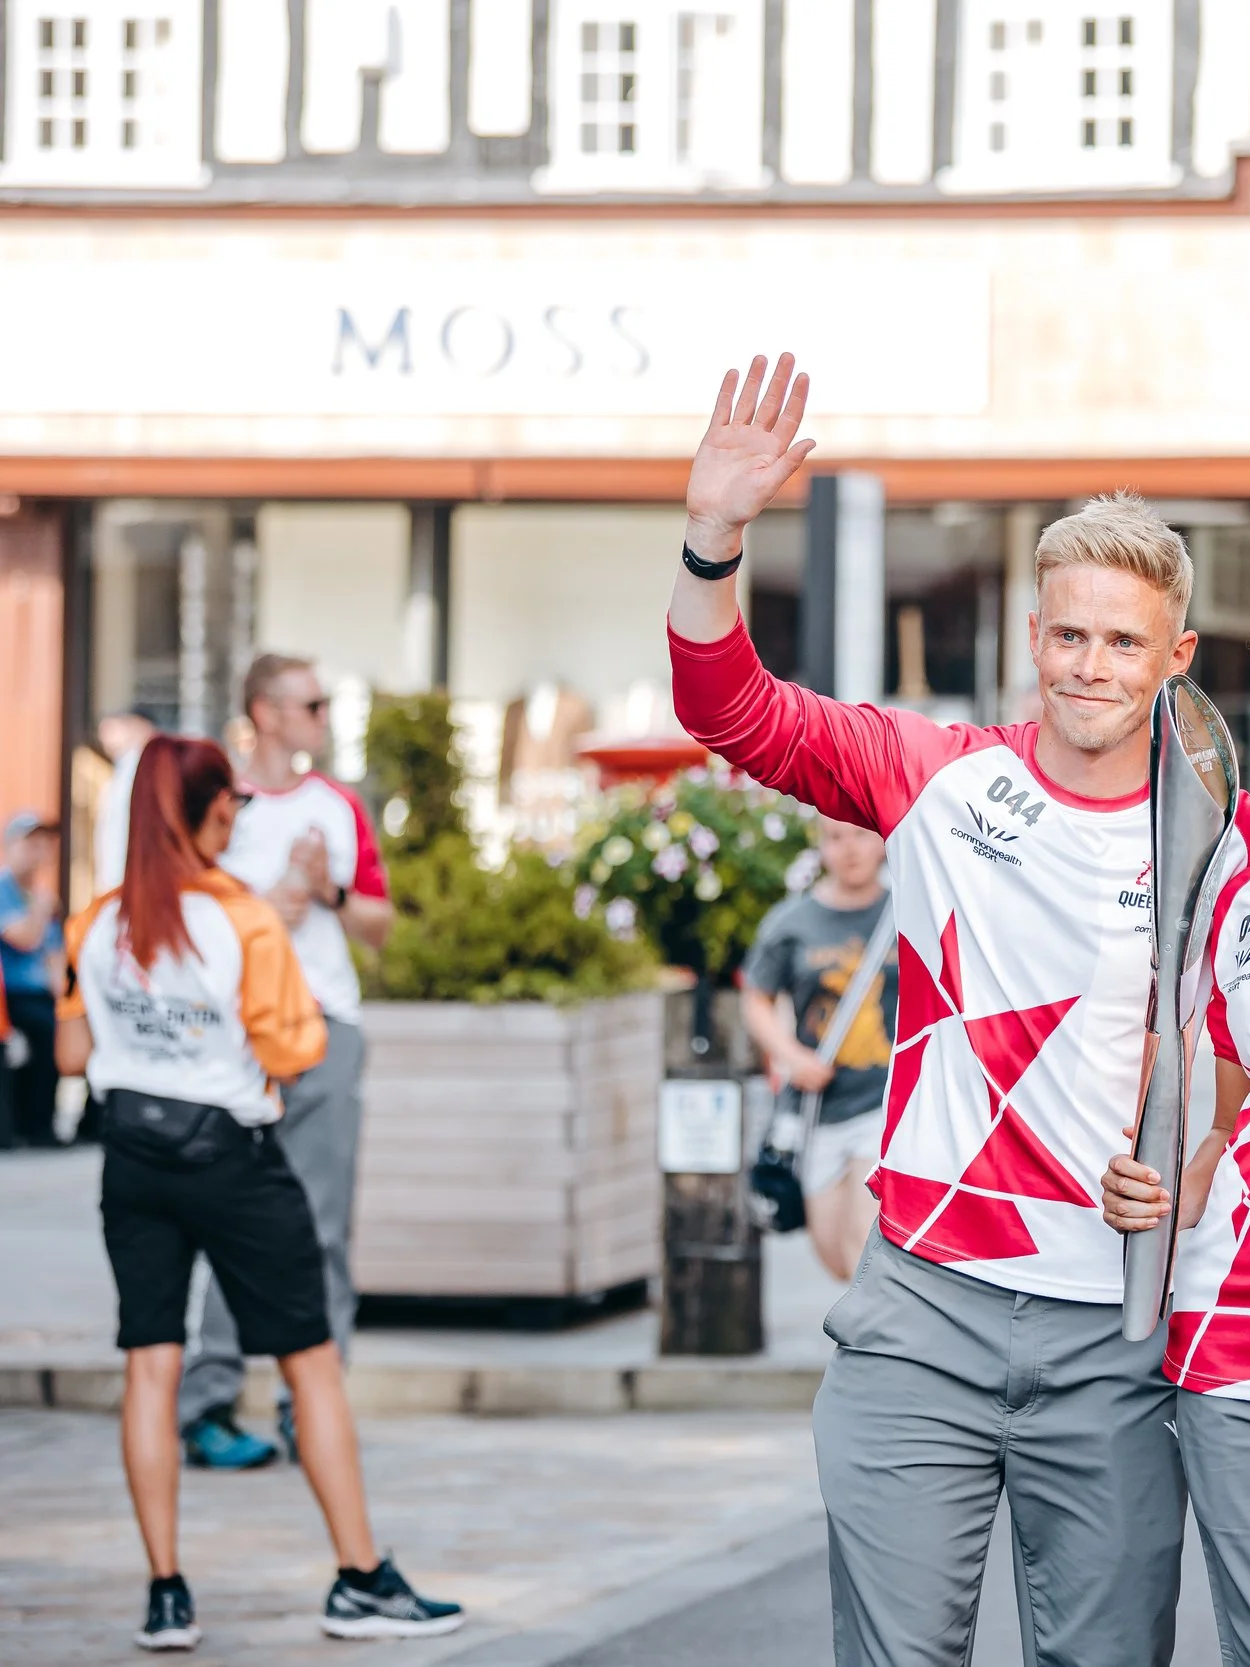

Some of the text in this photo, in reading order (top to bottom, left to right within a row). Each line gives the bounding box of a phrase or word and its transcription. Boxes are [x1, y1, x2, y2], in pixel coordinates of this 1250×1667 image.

[331, 304, 650, 379] MOSS
[986, 776, 1046, 827] 044
[951, 827, 1022, 866] commonwealth
[972, 846, 998, 863] sport
[1118, 890, 1152, 909] QUEE
